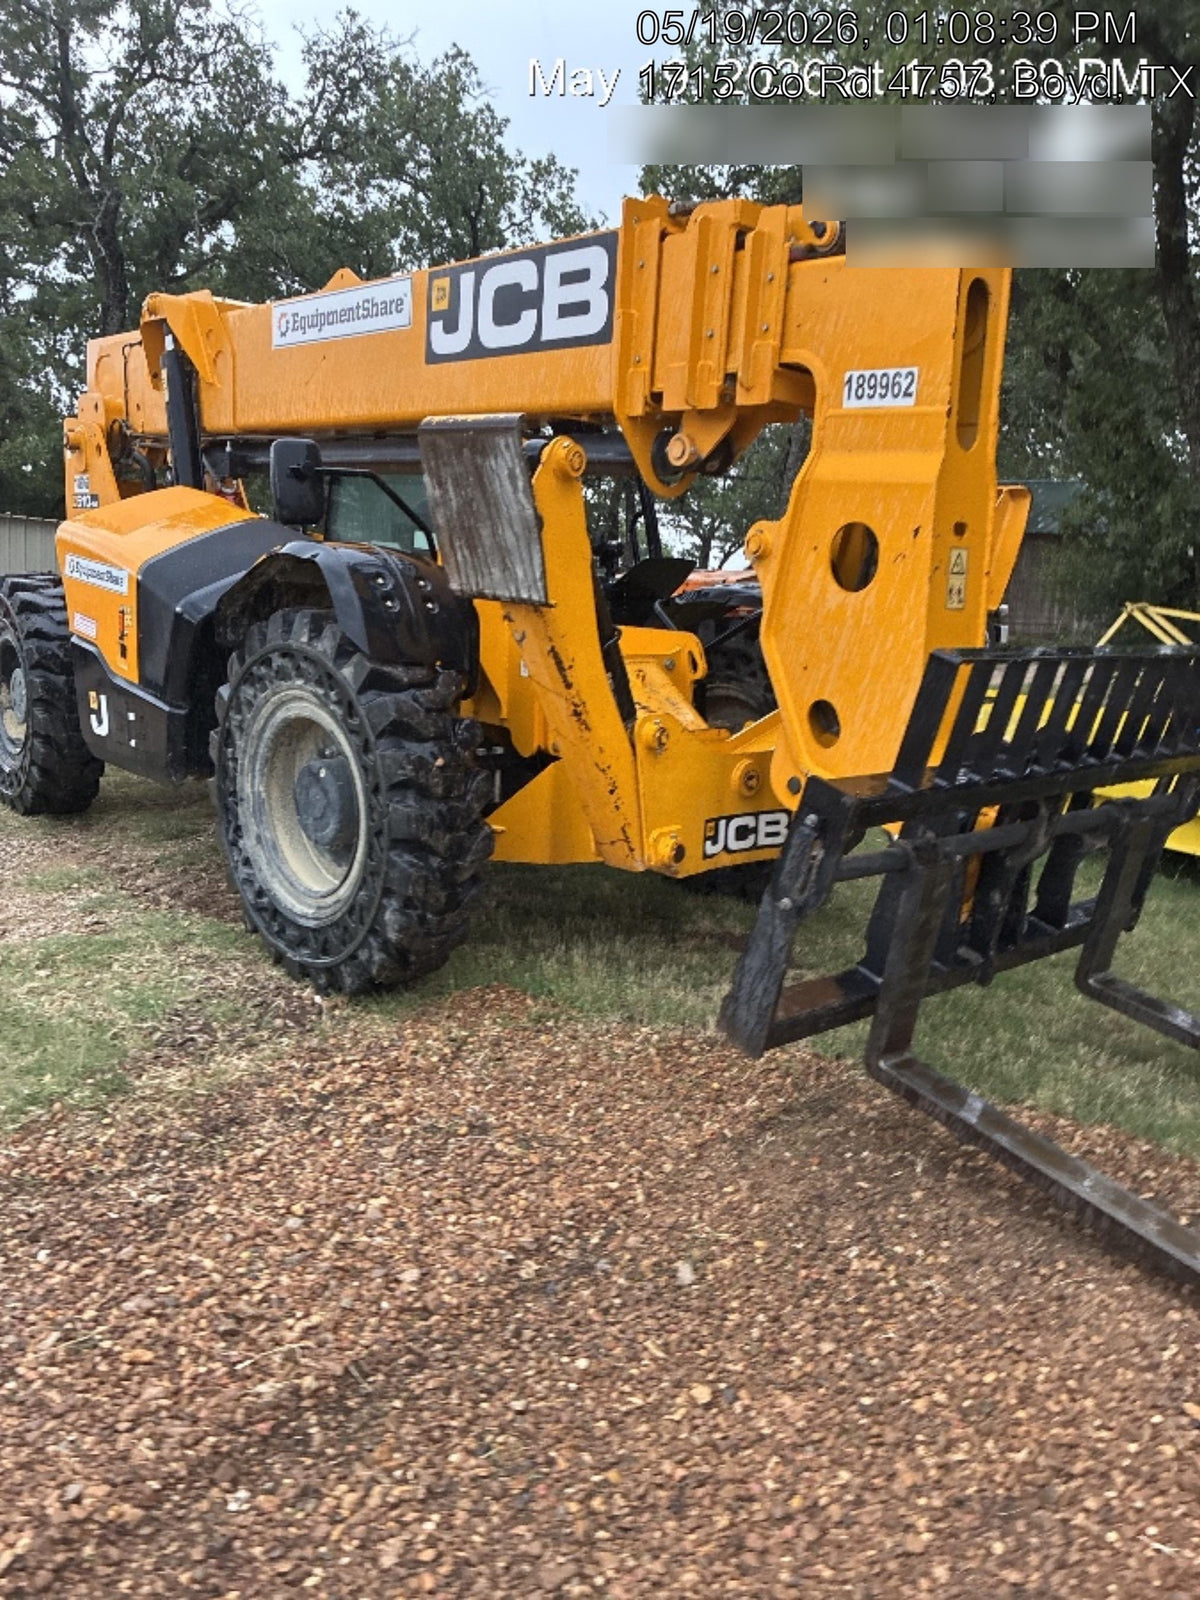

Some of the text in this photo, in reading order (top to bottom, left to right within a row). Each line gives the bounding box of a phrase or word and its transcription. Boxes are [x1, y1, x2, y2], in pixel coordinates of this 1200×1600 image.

[290, 296, 405, 334] EquipmentShare
[430, 246, 609, 354] JCB
[844, 370, 915, 401] 189962
[704, 812, 789, 856] JCB
